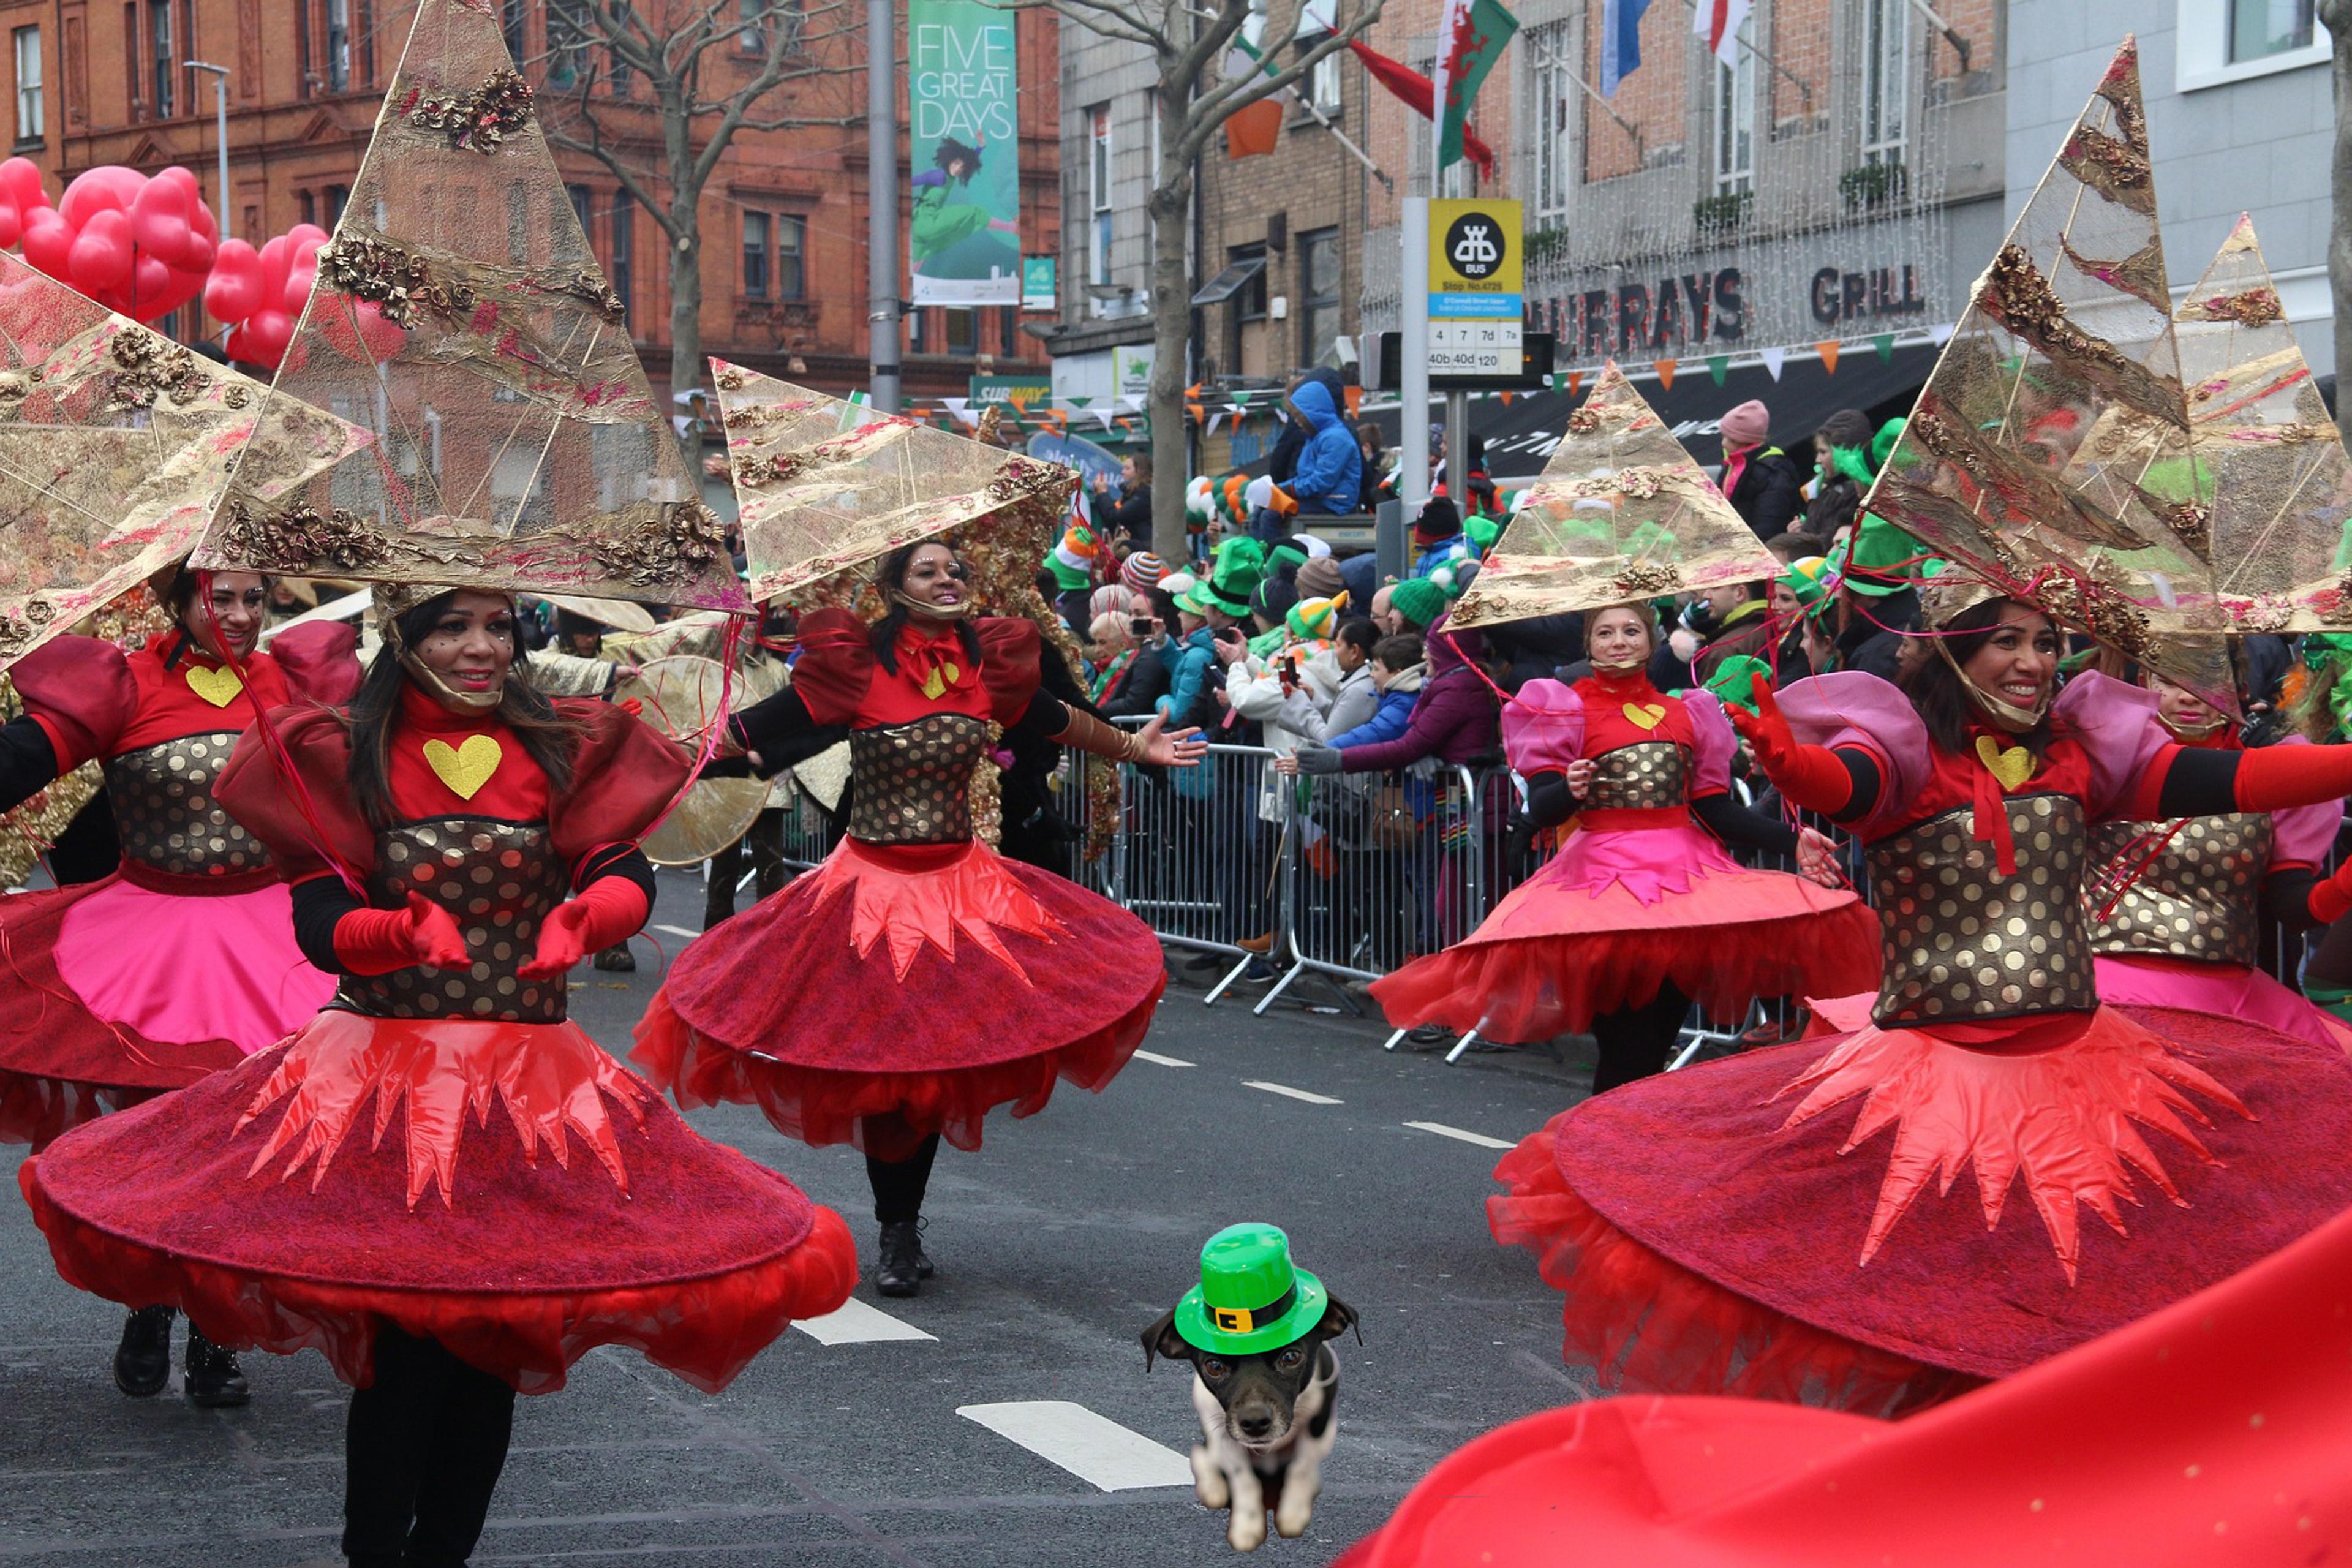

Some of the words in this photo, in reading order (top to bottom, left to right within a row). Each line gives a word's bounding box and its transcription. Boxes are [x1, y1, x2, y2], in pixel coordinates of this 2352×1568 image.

[917, 24, 1009, 70] FIVE
[917, 72, 1009, 99] GREAT
[919, 101, 1012, 140] DAYS
[1466, 264, 1486, 274] BUS
[1442, 282, 1464, 292] Stop
[1811, 265, 1925, 322] GRILL
[1436, 330, 1444, 341] 4
[1460, 330, 1468, 341] 7
[1482, 330, 1494, 341] 7d
[1506, 331, 1517, 339] 7a
[1428, 353, 1450, 364] 40b
[1453, 353, 1475, 364] 40d
[1479, 356, 1498, 366] 120
[976, 386, 1050, 404] SUBWAY
